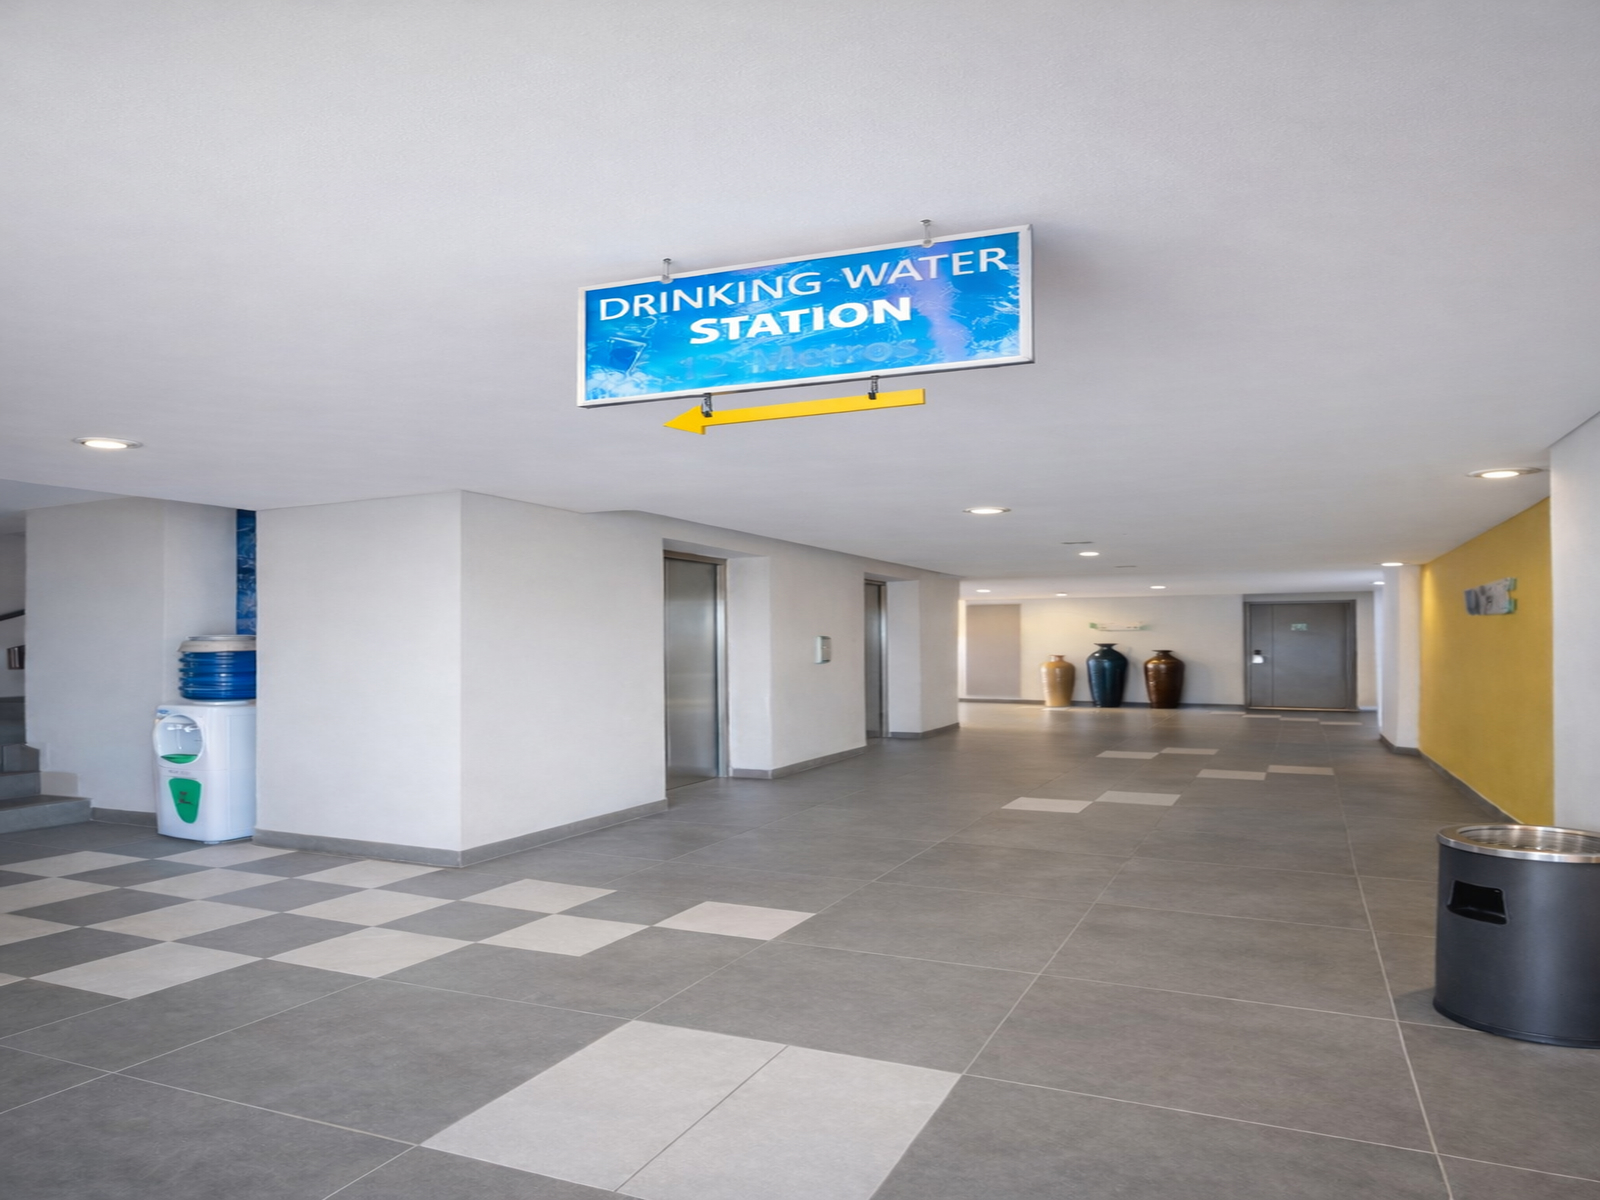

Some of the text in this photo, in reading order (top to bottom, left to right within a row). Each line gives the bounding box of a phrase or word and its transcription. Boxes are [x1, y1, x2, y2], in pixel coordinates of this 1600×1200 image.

[599, 247, 1009, 321] DRINKING WATER
[689, 296, 911, 345] STATION
